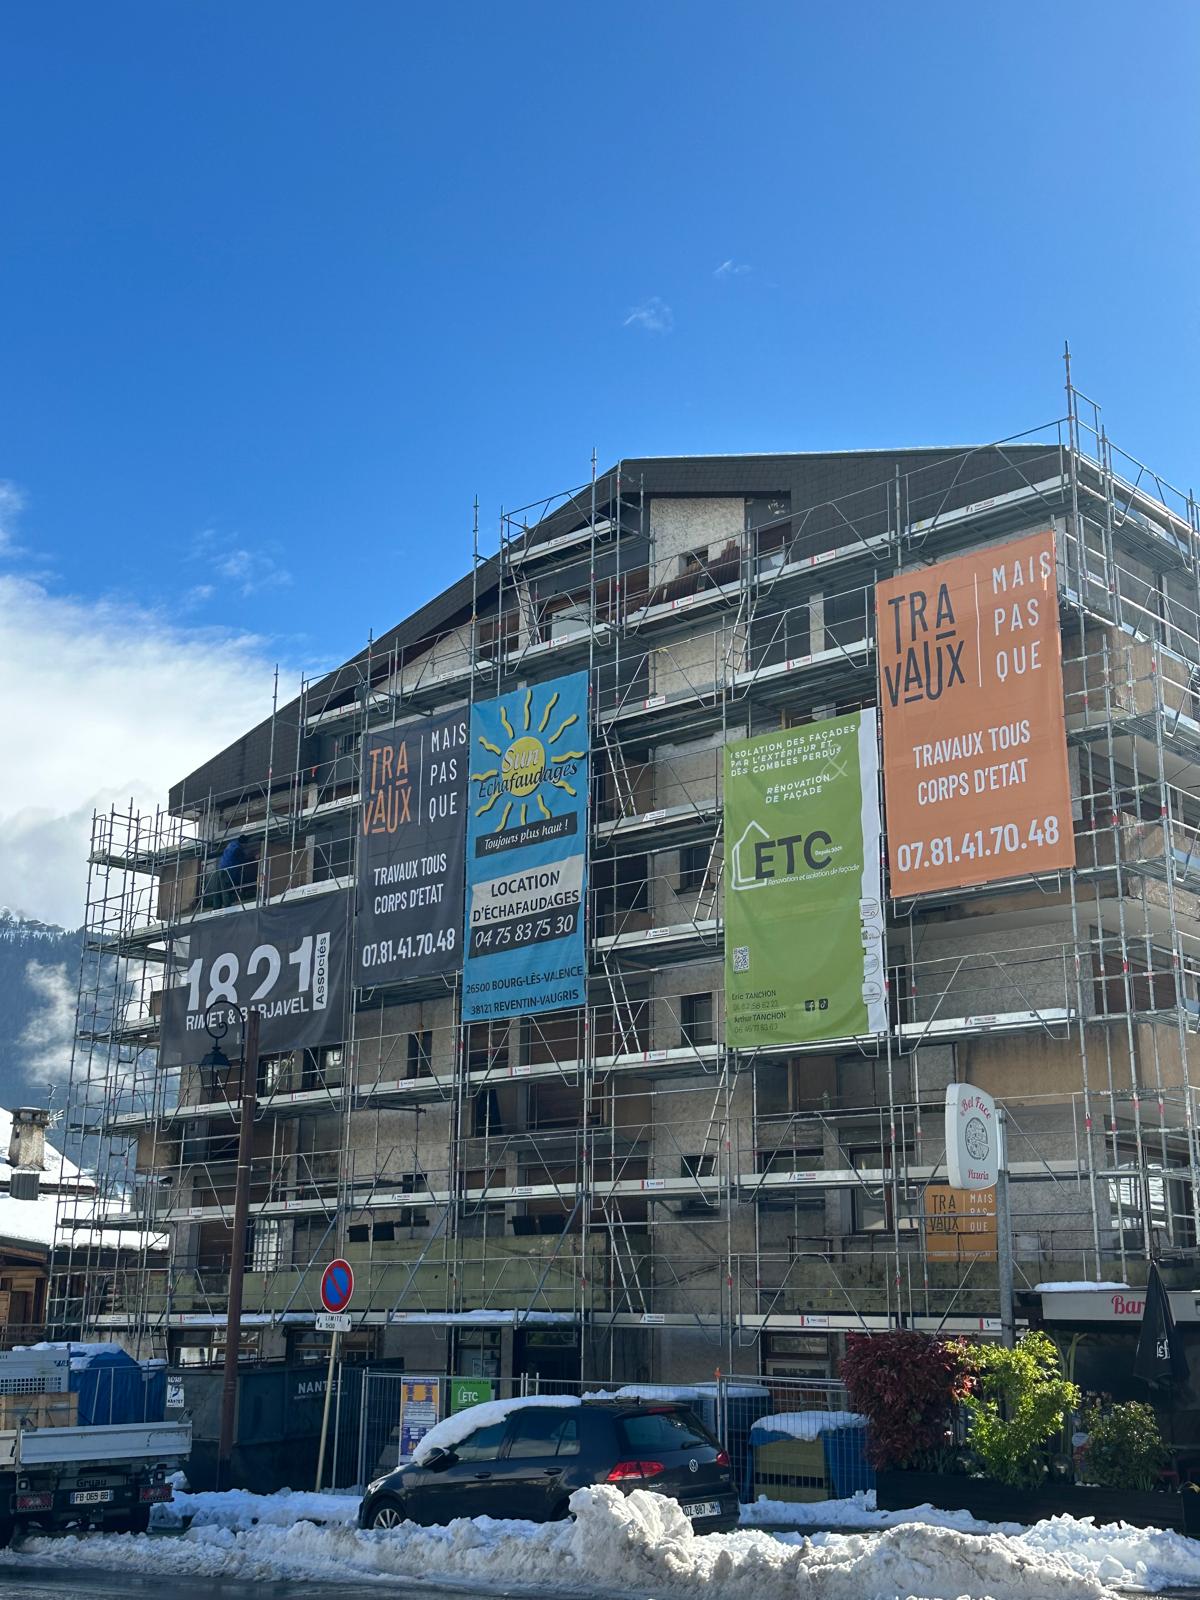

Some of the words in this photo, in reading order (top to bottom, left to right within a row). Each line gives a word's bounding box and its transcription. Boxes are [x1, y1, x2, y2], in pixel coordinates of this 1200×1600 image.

[993, 551, 1052, 594] MAIS
[888, 583, 956, 654] TRA
[994, 599, 1040, 636] PAS
[884, 640, 966, 707] VAUX
[996, 641, 1042, 682] QUE
[431, 723, 467, 753] MAIS
[730, 742, 783, 759] ISOLATION
[786, 738, 805, 748] DES
[809, 725, 856, 741] FAÇADES
[912, 730, 984, 769] TRAVAUX
[988, 719, 1031, 751] TOUS
[370, 741, 409, 795] TRA
[502, 748, 540, 774] Sun
[730, 759, 749, 768] PAR
[752, 744, 816, 764] L'EXTÉRIEUR
[820, 740, 833, 749] ET
[730, 768, 748, 777] DES
[752, 757, 798, 774] COMBLES
[802, 746, 842, 762] PERDUS
[430, 759, 457, 786] PAS
[766, 773, 831, 795] RÉNOVATION
[918, 772, 970, 805] CORPS
[974, 758, 1029, 793] D'ETAT
[429, 792, 458, 822] QUE
[765, 794, 780, 804] DE
[783, 785, 823, 801] FAÇADE
[363, 785, 412, 836] VAUX
[485, 834, 519, 850] Toujours
[520, 828, 540, 844] plus
[541, 822, 563, 836] haut
[897, 815, 1060, 872] 07.81.41.70.48
[374, 860, 419, 886] TRAVAUX
[421, 853, 447, 876] TOUS
[755, 830, 833, 880] ETC
[374, 891, 408, 915] CORPS
[410, 884, 444, 908] D'ETAT
[491, 870, 560, 898] LOCATION
[473, 890, 579, 922] D'ÉCHAFAUDAGES
[475, 930, 492, 948] 04
[496, 926, 511, 945] 75
[514, 923, 532, 941] 83
[534, 919, 551, 939] 75
[555, 914, 574, 934] 30
[362, 928, 456, 967] 07.81.41.70.48
[187, 936, 313, 1011] 1821
[315, 936, 327, 1005] Associés
[466, 982, 491, 994] 26500
[471, 1003, 492, 1015] 38121
[494, 989, 579, 1013] REVENTIN-VAUGRIS
[745, 989, 777, 999] TANCHON
[227, 1009, 236, 1025] &
[239, 997, 309, 1023] BRJAVEL
[753, 1011, 786, 1021] TANCHON
[932, 1194, 956, 1213] TRA
[970, 1193, 993, 1204] MAIS
[1111, 1294, 1146, 1315] Bar
[462, 1391, 478, 1402] ETC
[76, 1478, 107, 1488] Gruau
